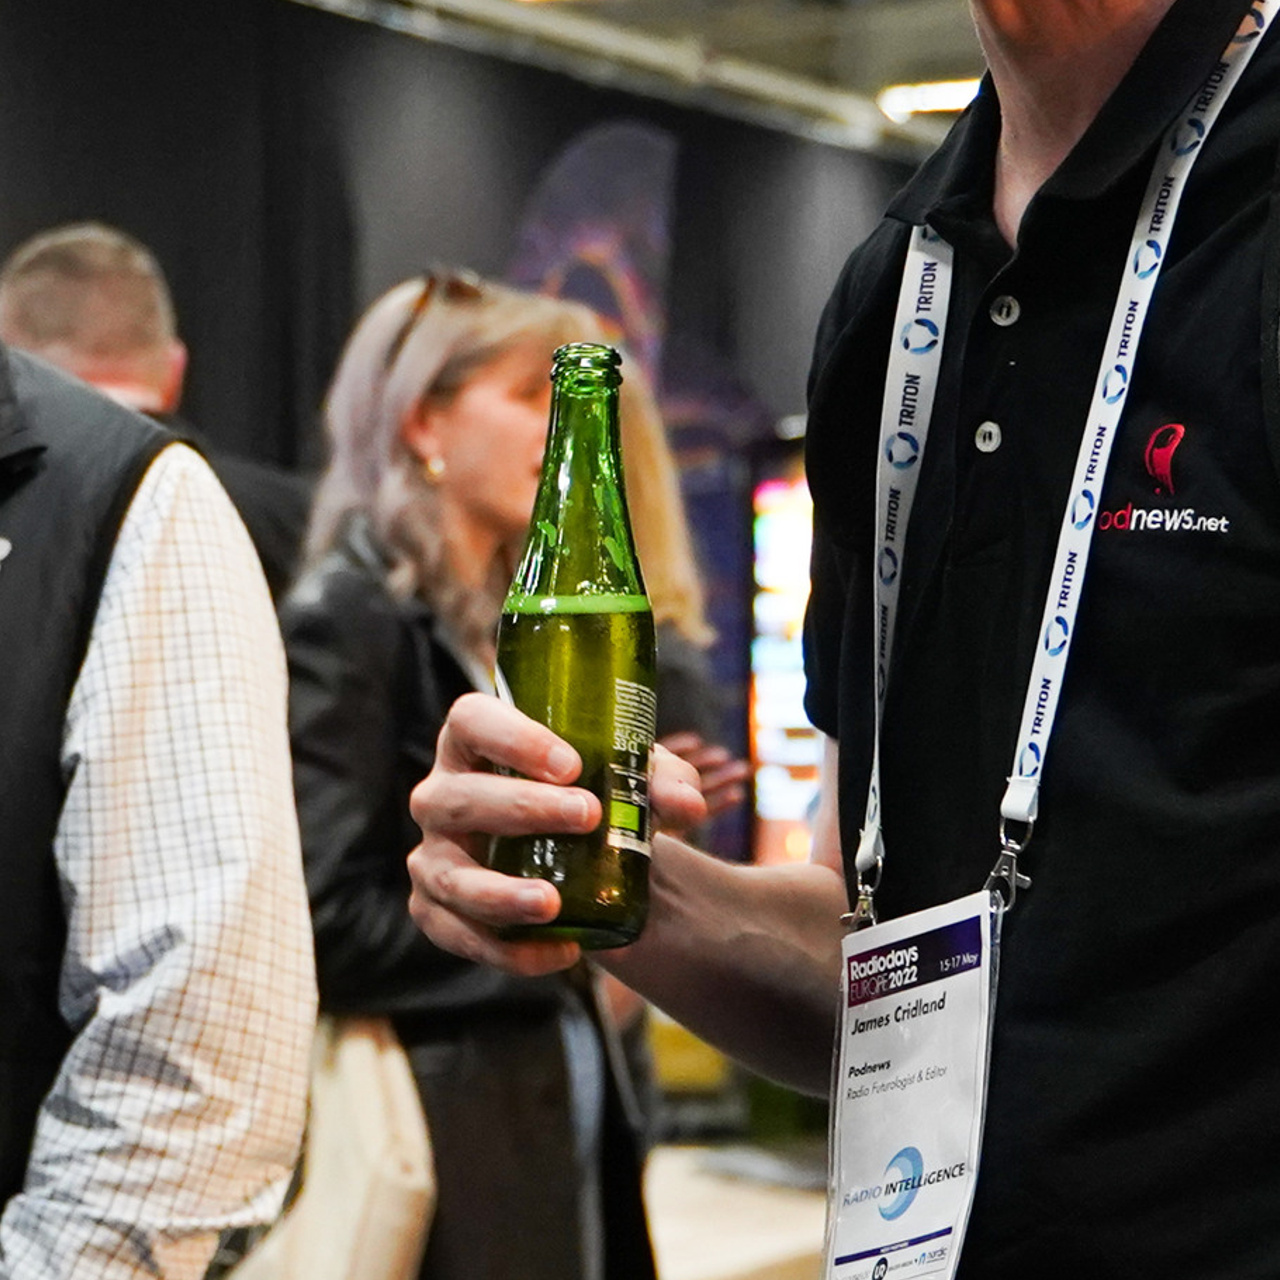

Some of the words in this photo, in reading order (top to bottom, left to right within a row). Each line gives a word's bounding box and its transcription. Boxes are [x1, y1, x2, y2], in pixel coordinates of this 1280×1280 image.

[1149, 175, 1176, 235] TRITON
[915, 261, 938, 314] TRITON
[1117, 299, 1140, 359] TRITON
[898, 372, 921, 427] TRITON
[1084, 425, 1108, 484] TRITON
[885, 486, 902, 542] TRITON
[1098, 502, 1230, 533] odnews.net
[1057, 550, 1078, 610] TRITON
[1031, 677, 1052, 737] TRITON
[850, 946, 919, 980] Radiodays
[850, 973, 890, 1001] EUROPE
[889, 965, 918, 989] 2022
[940, 954, 961, 972] 15-17
[851, 1013, 891, 1035] James
[894, 991, 947, 1023] Cridland
[847, 1082, 870, 1100] Radio
[848, 1059, 892, 1078] Podnews
[843, 1186, 882, 1207] RADIO
